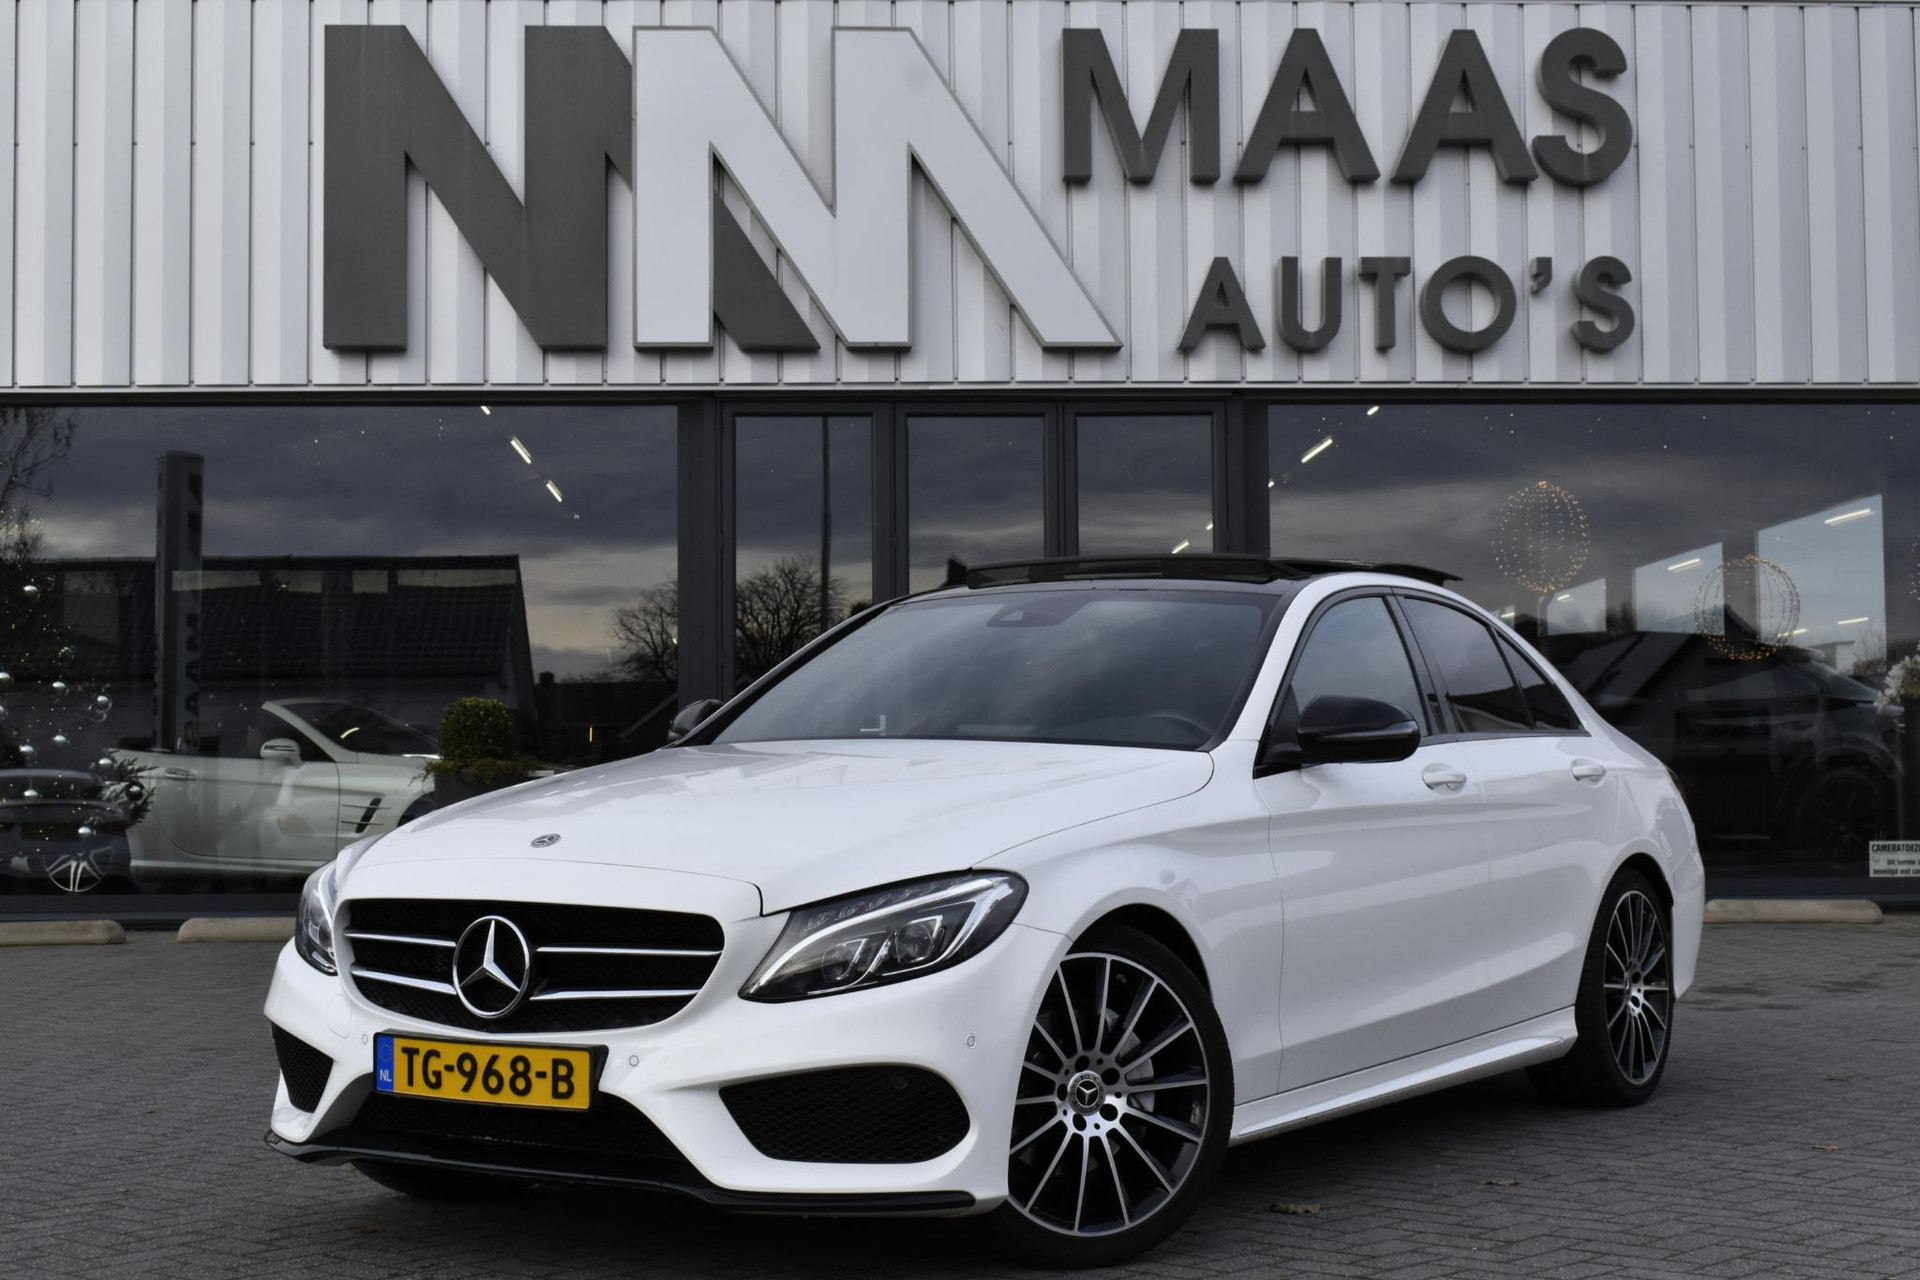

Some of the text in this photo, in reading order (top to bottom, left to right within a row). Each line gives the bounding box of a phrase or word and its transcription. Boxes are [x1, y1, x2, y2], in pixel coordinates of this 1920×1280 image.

[1062, 28, 1633, 186] MAAS
[1178, 255, 1635, 354] AUTO'S
[380, 1069, 392, 1082] NL
[401, 1046, 575, 1100] TG-968-B
